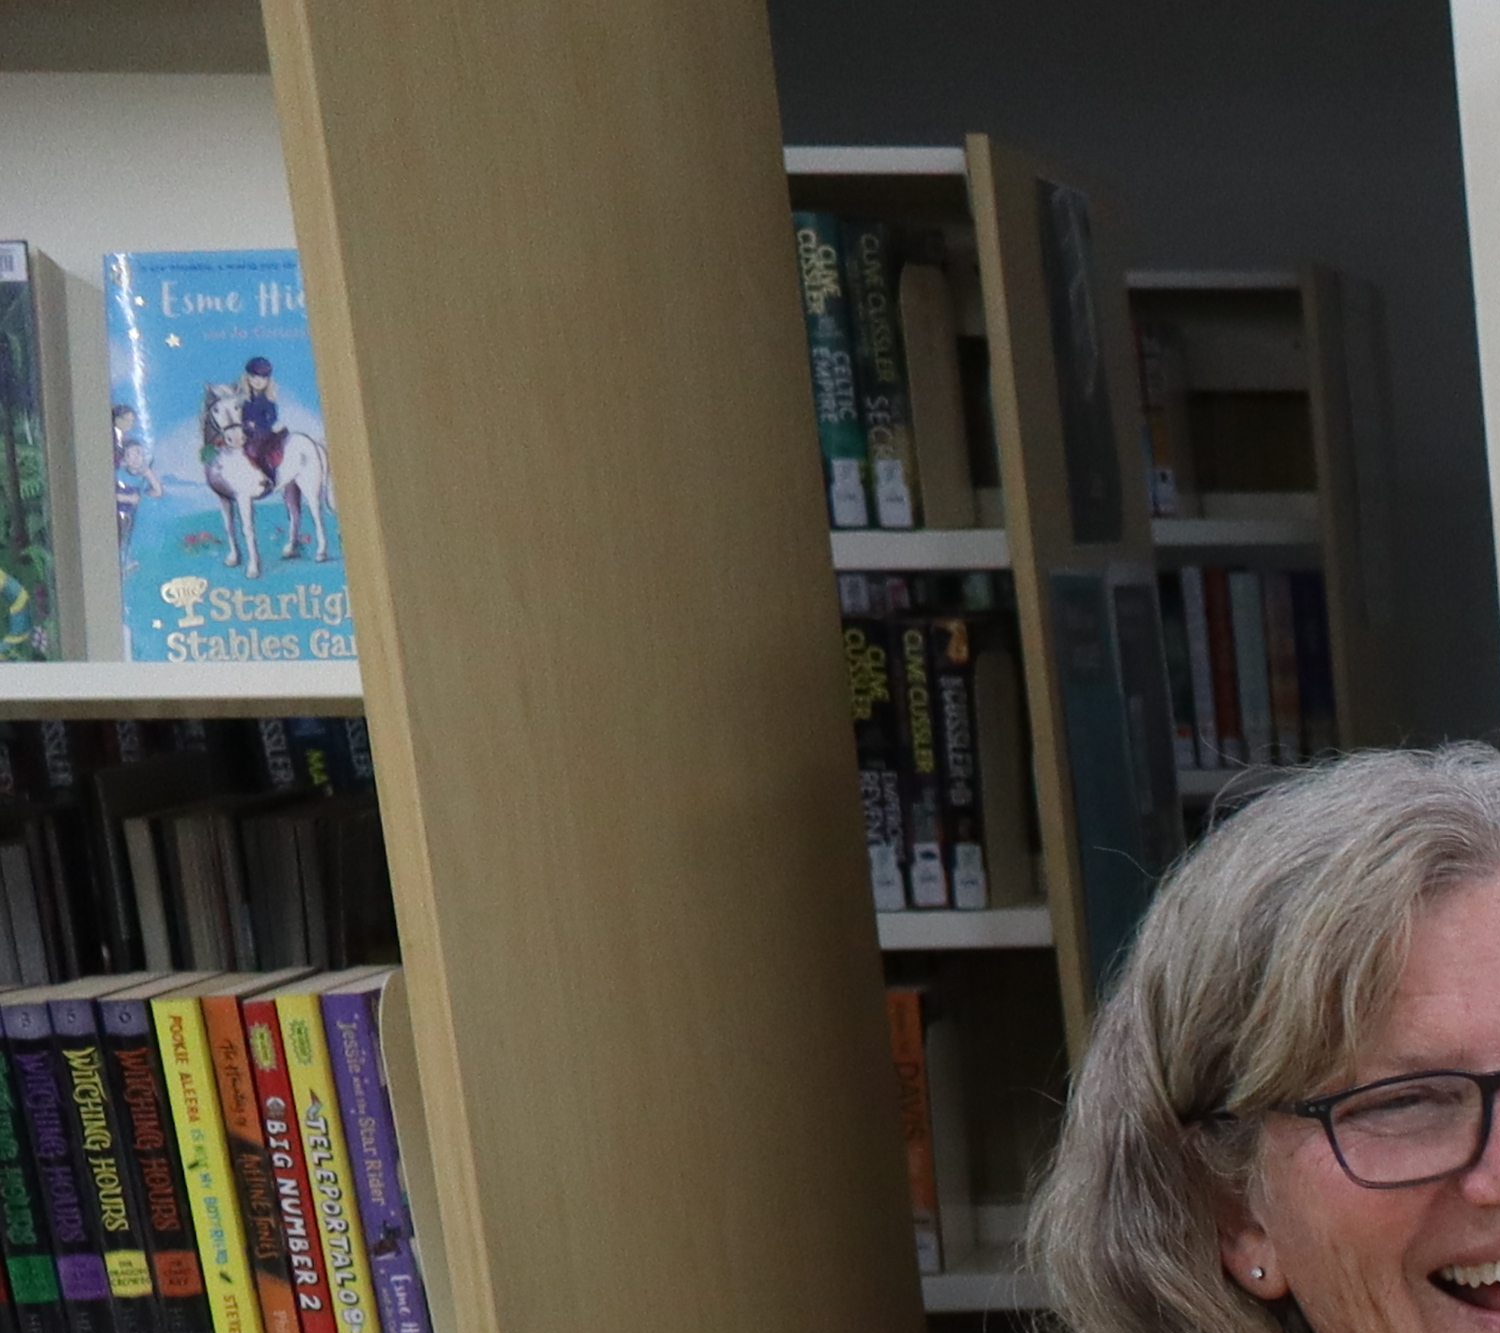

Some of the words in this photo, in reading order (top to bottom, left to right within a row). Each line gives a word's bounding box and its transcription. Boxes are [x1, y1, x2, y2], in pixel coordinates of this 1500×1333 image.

[161, 280, 243, 317] Esme
[167, 628, 301, 662] Stables
[62, 1045, 112, 1151] WITCHING
[92, 1159, 129, 1231] HOURS
[266, 1119, 293, 1168] BIG
[276, 1176, 319, 1288] NUMBER
[299, 1294, 322, 1311] 2
